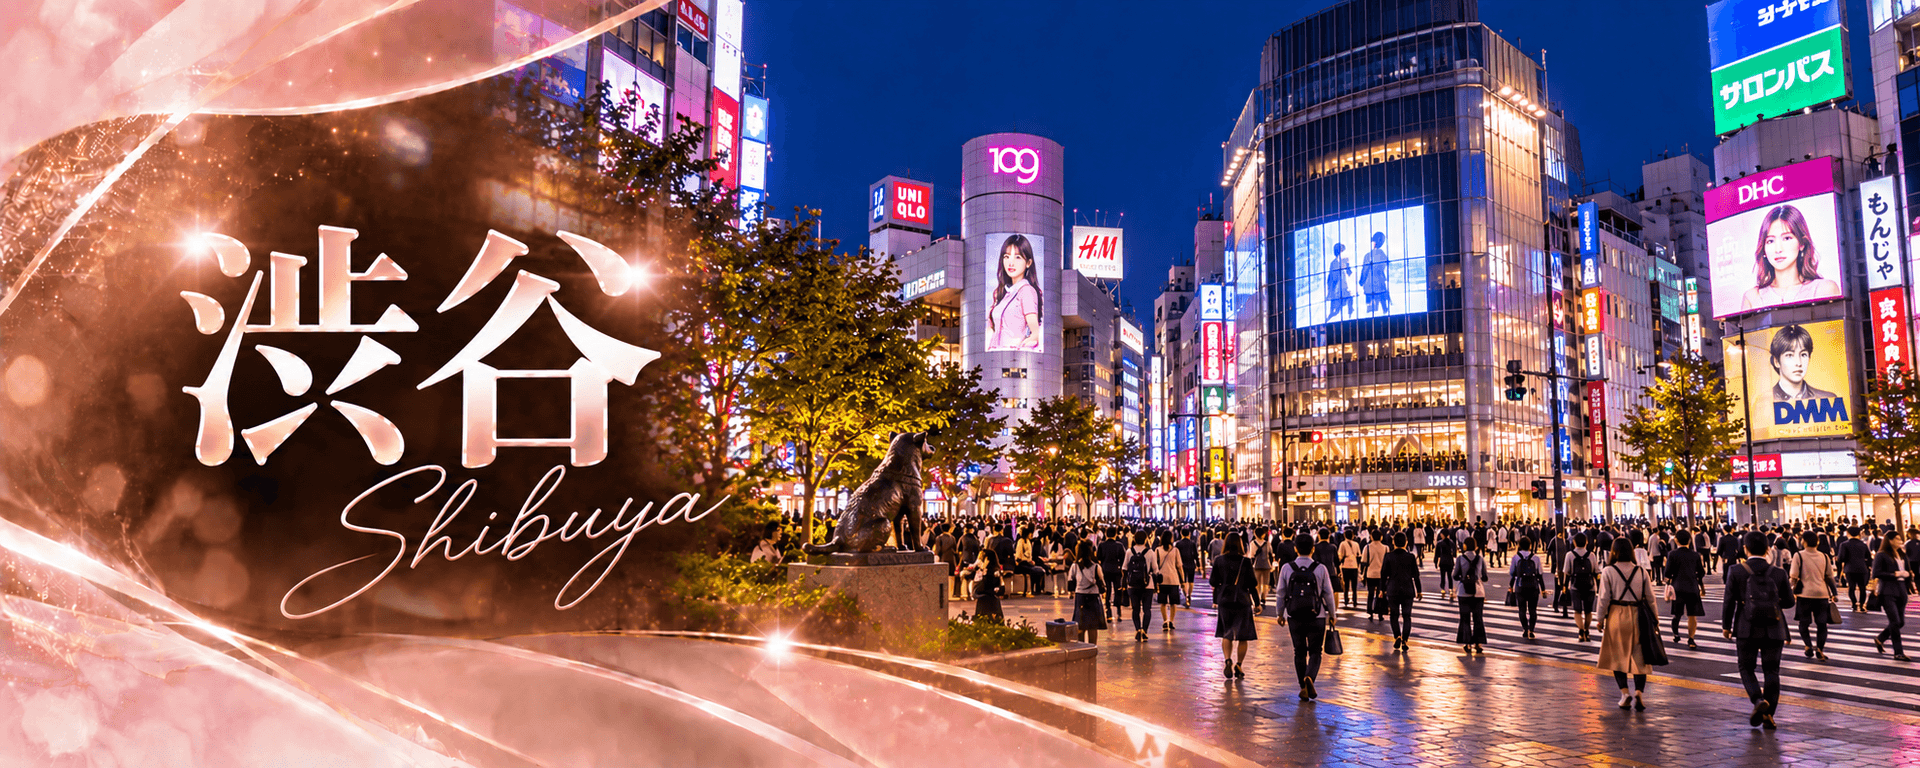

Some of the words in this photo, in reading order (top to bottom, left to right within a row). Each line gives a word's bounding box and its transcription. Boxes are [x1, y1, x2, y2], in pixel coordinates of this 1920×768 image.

[1719, 49, 1835, 110] サロンパス
[988, 146, 1040, 185] 109
[897, 186, 923, 204] UNI
[1737, 174, 1785, 206] DHC
[896, 202, 926, 220] QLO
[1867, 192, 1894, 281] もんじゃ
[1772, 397, 1850, 425] DMM
